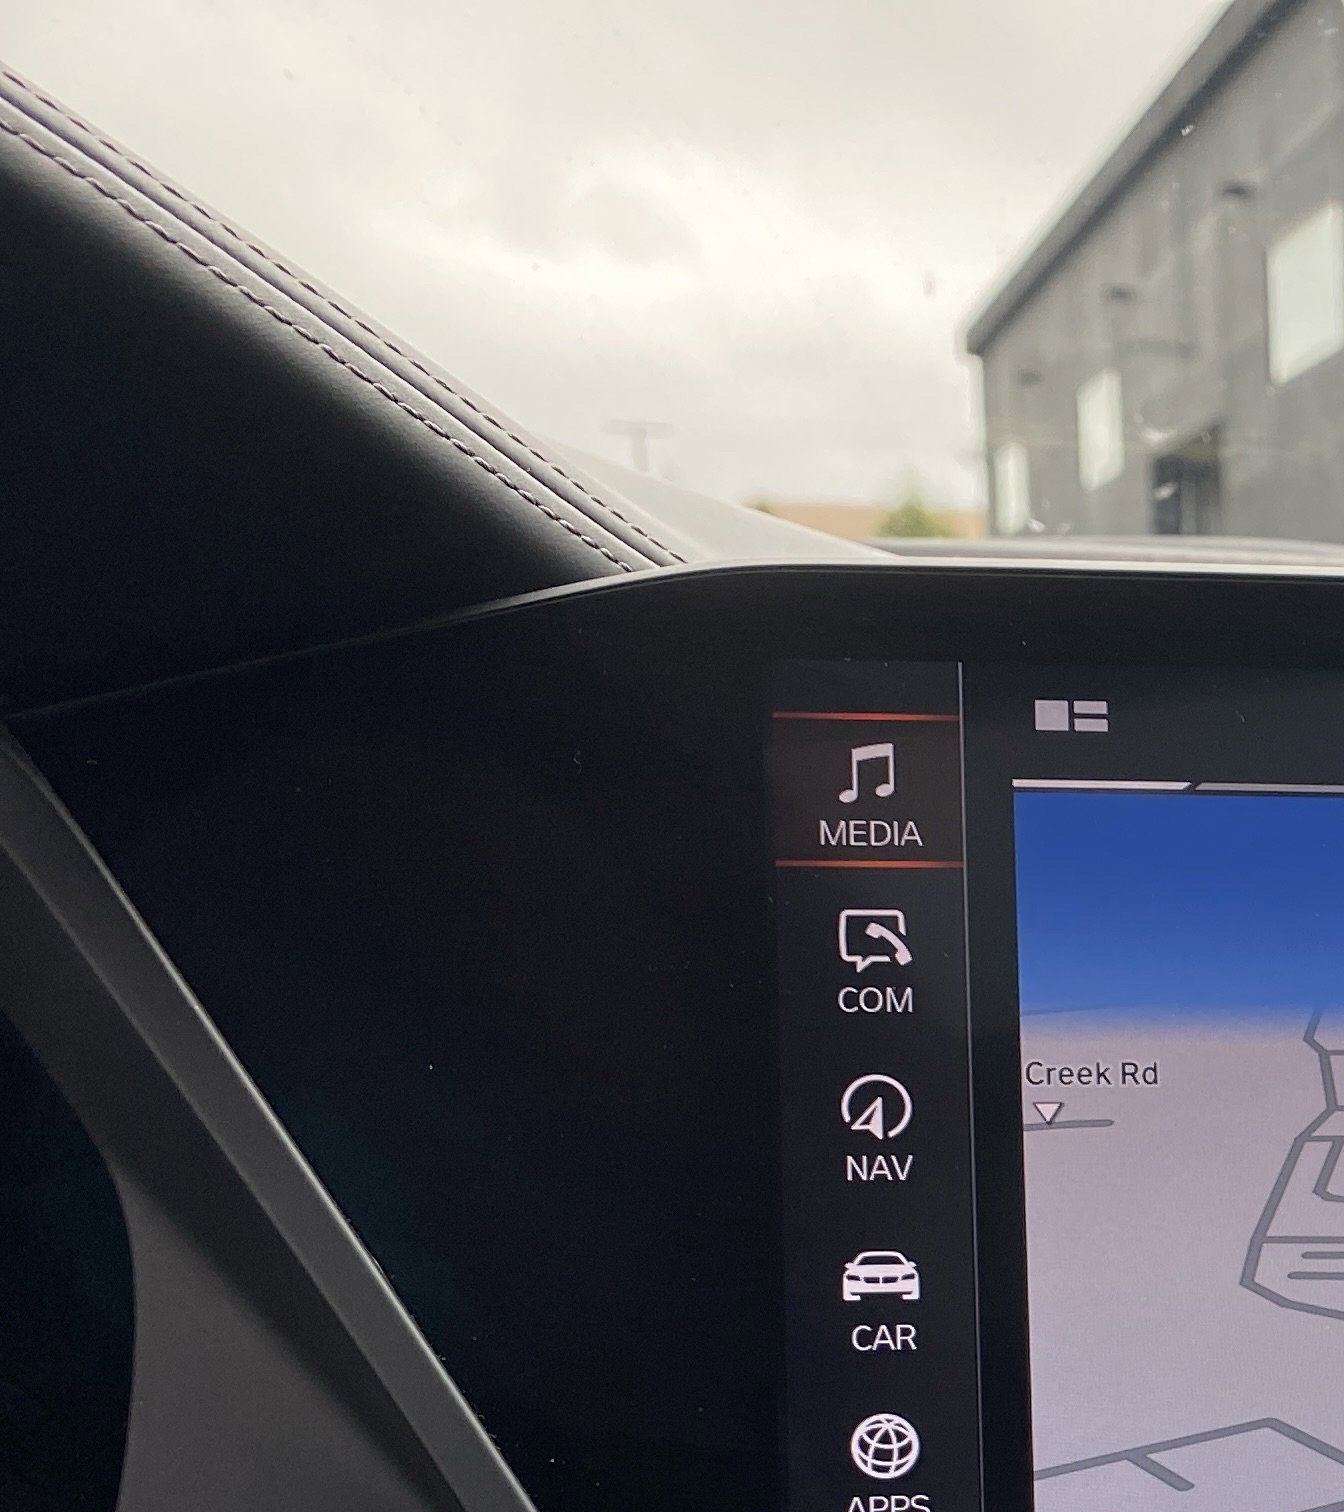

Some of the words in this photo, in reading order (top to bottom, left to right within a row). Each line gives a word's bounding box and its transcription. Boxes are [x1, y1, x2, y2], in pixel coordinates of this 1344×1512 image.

[819, 820, 923, 847] MEDIA
[837, 986, 913, 1013] COM
[1025, 1061, 1112, 1086] Creek
[1121, 1062, 1158, 1085] Rd
[846, 1154, 913, 1181] NAV
[851, 1324, 918, 1351] CAR
